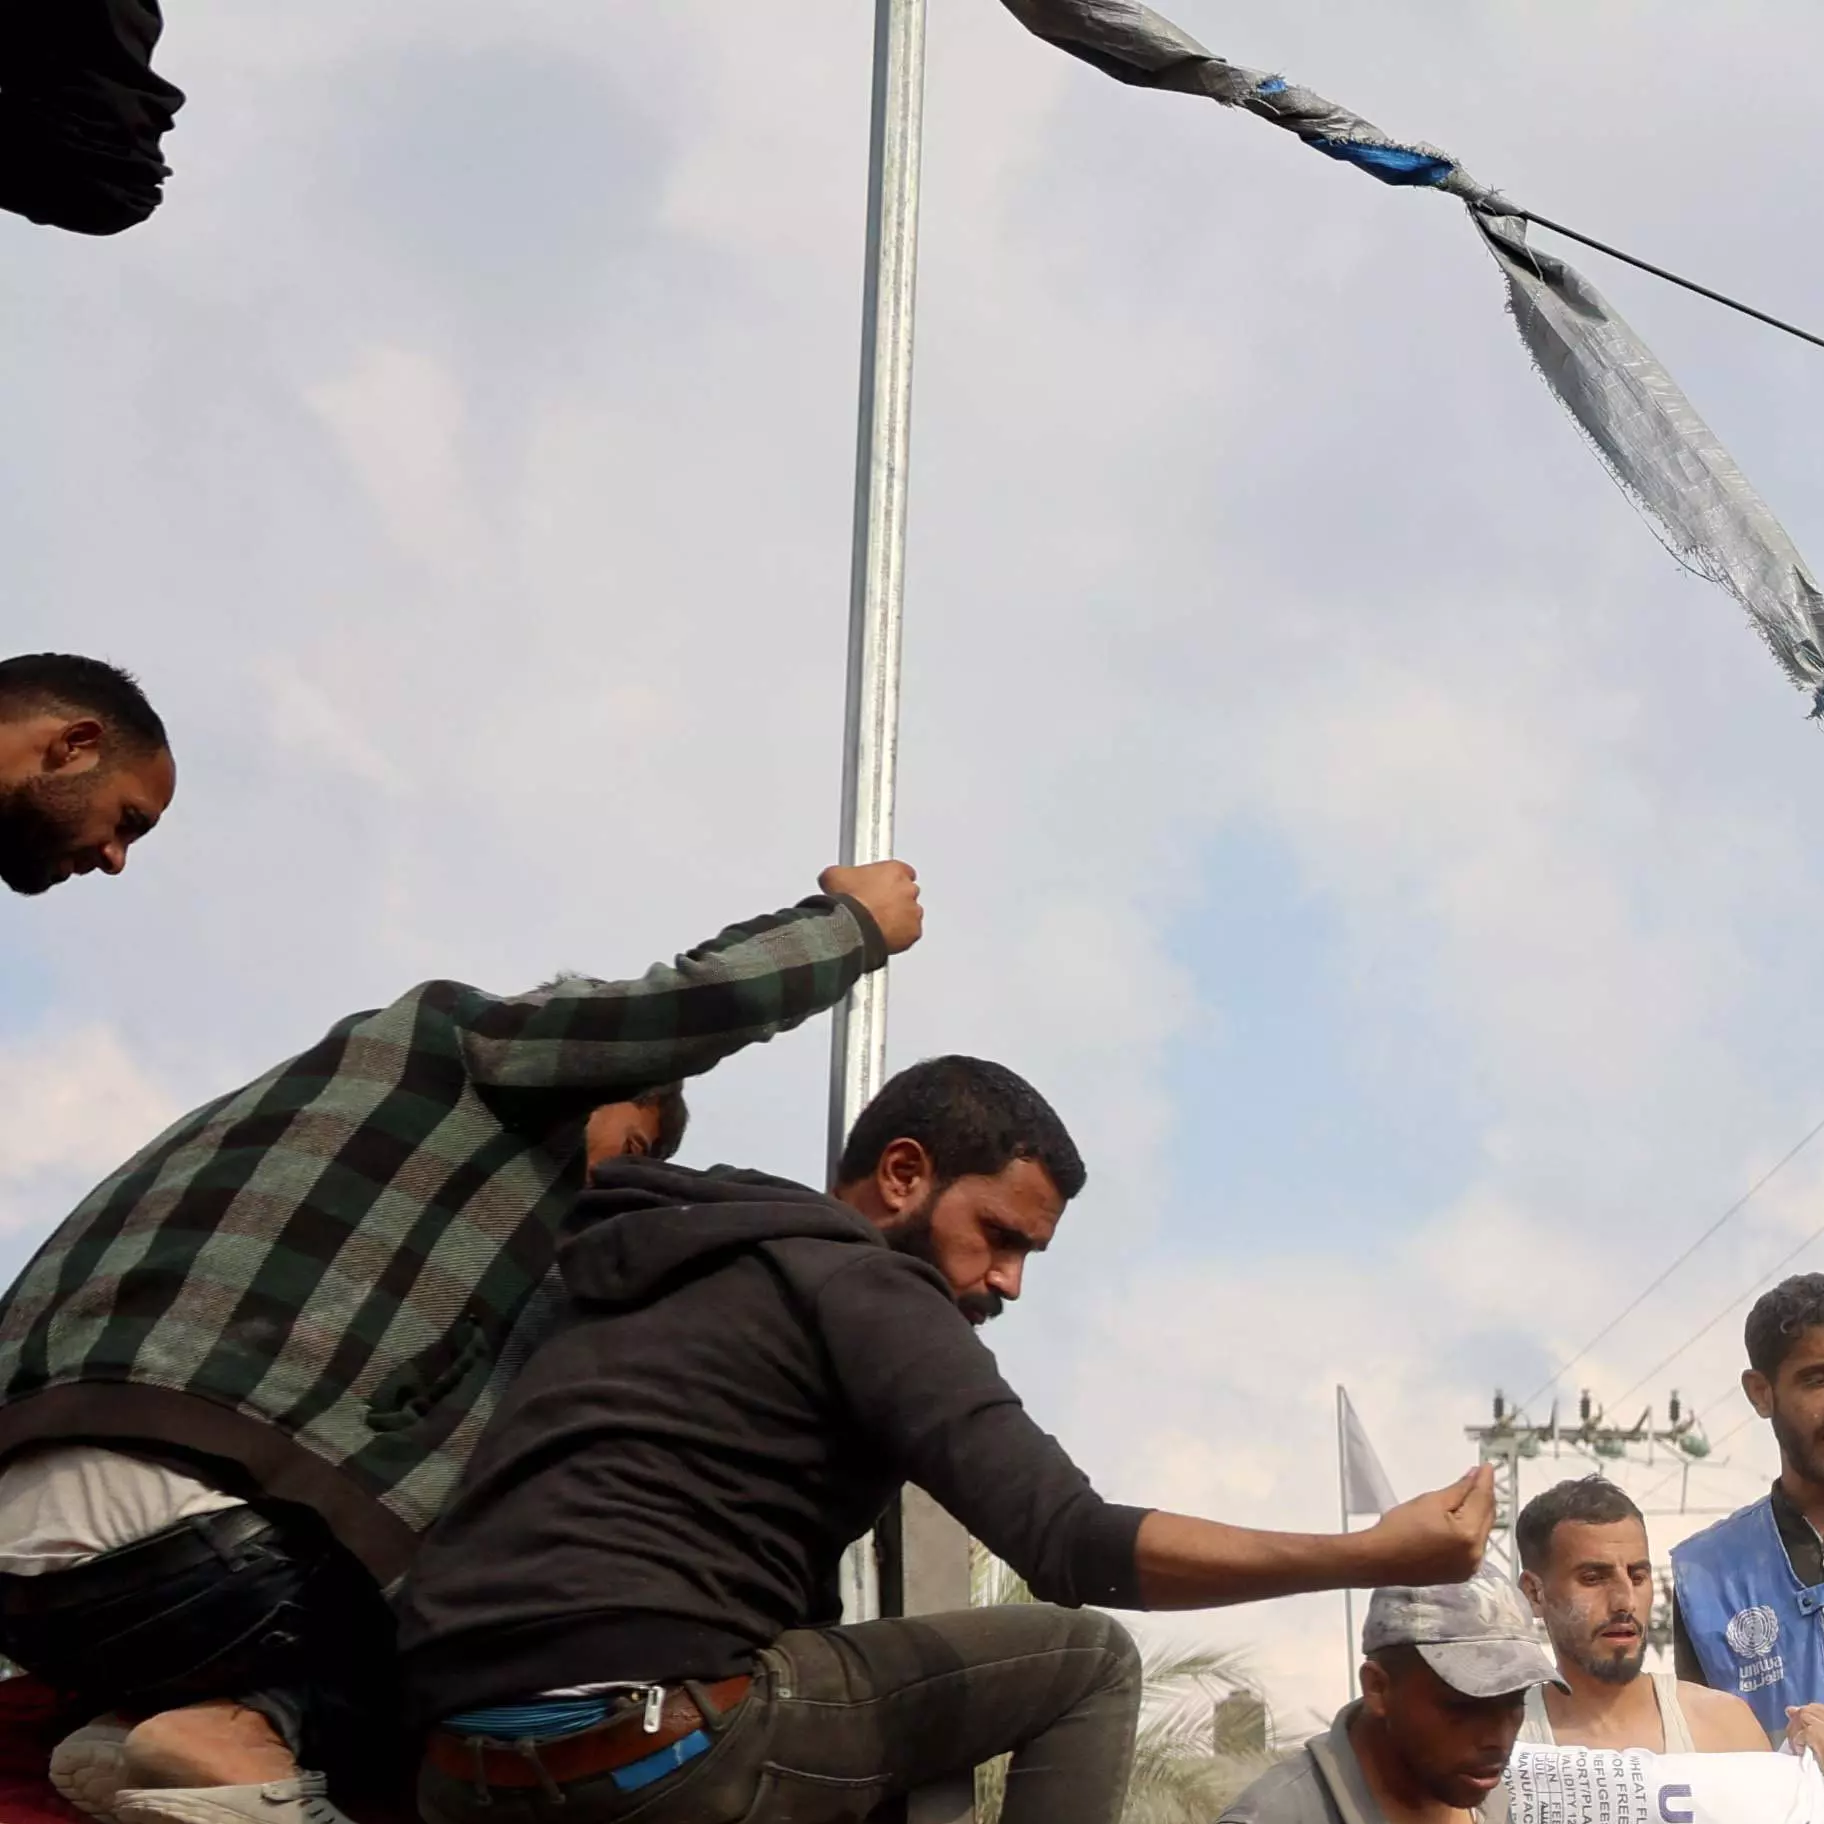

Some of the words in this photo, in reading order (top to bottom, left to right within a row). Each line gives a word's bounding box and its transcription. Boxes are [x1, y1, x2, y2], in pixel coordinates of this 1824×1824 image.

[1535, 1757, 1546, 1778] JUL
[1546, 1757, 1559, 1783] JAN
[1562, 1754, 1578, 1808] VALIDITY
[1629, 1755, 1647, 1801] WHEAT
